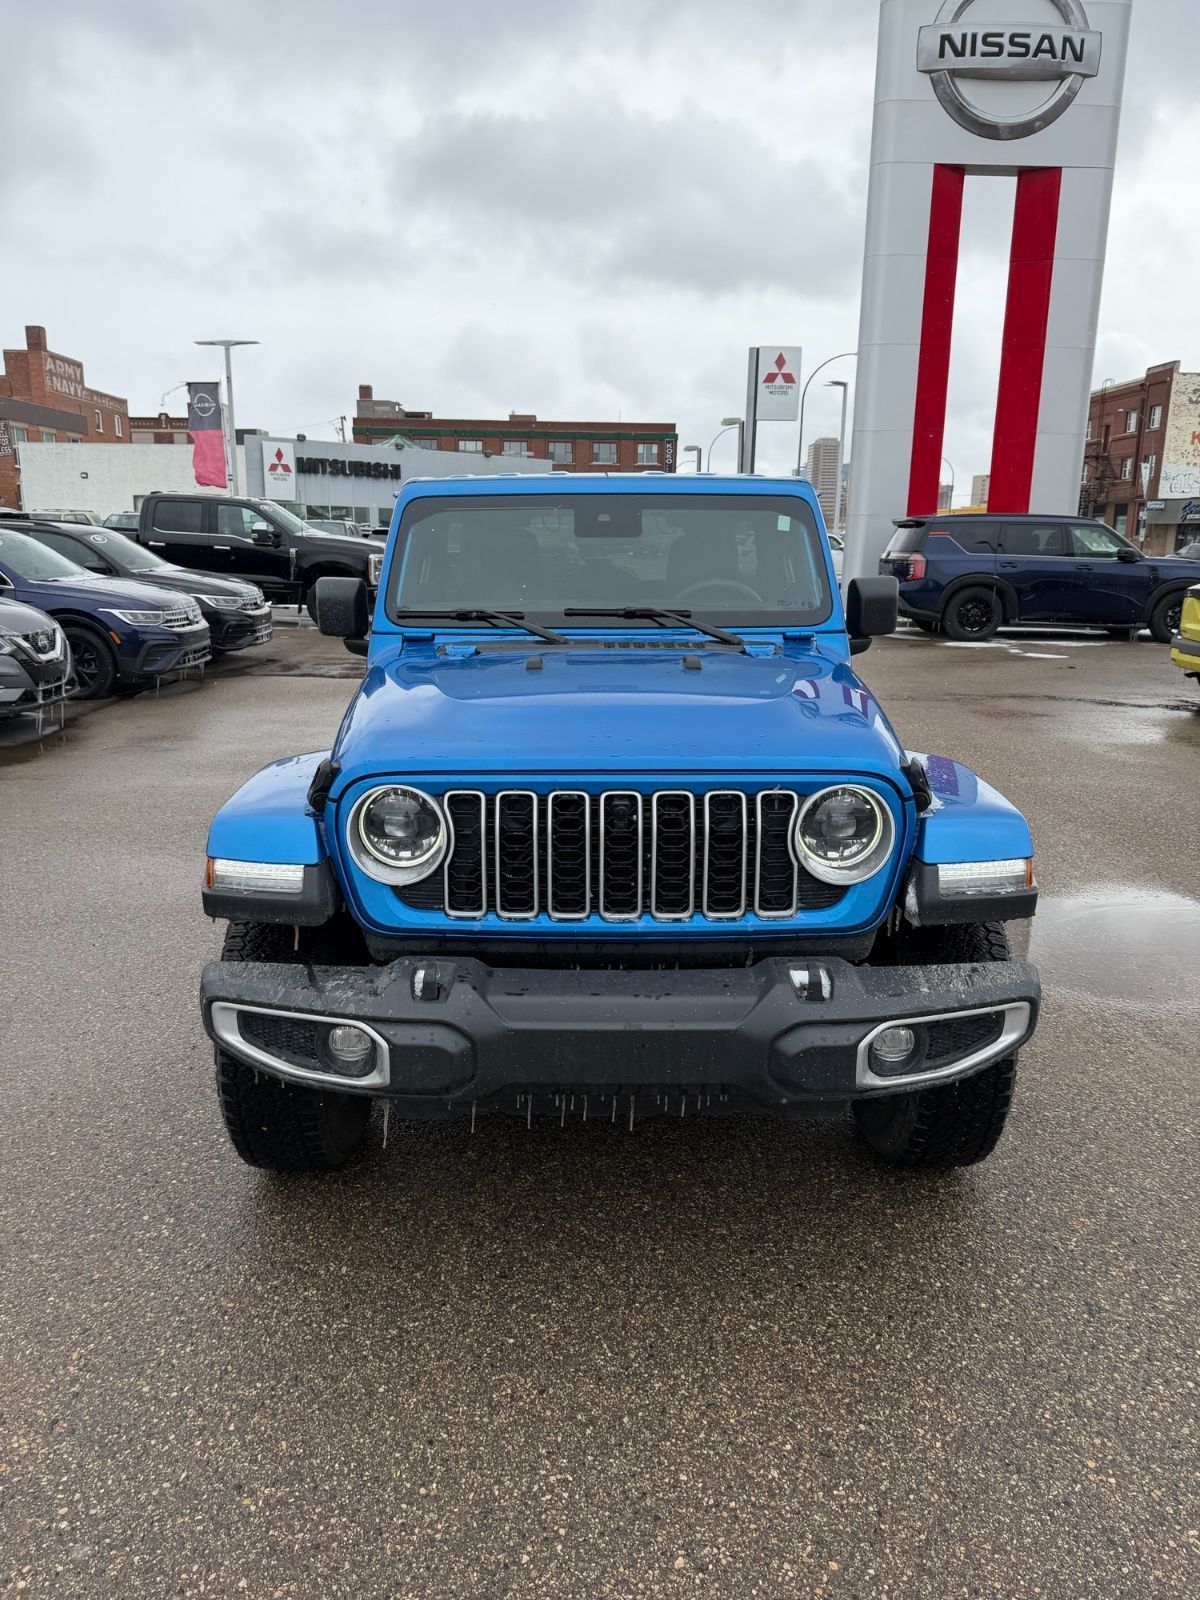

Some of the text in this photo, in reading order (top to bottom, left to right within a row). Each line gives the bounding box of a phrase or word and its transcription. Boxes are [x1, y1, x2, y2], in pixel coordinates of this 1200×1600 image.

[938, 31, 1086, 63] NISSAN
[46, 357, 81, 380] ARMY
[52, 376, 82, 398] NAVY
[296, 457, 401, 480] MITSUBISHI
